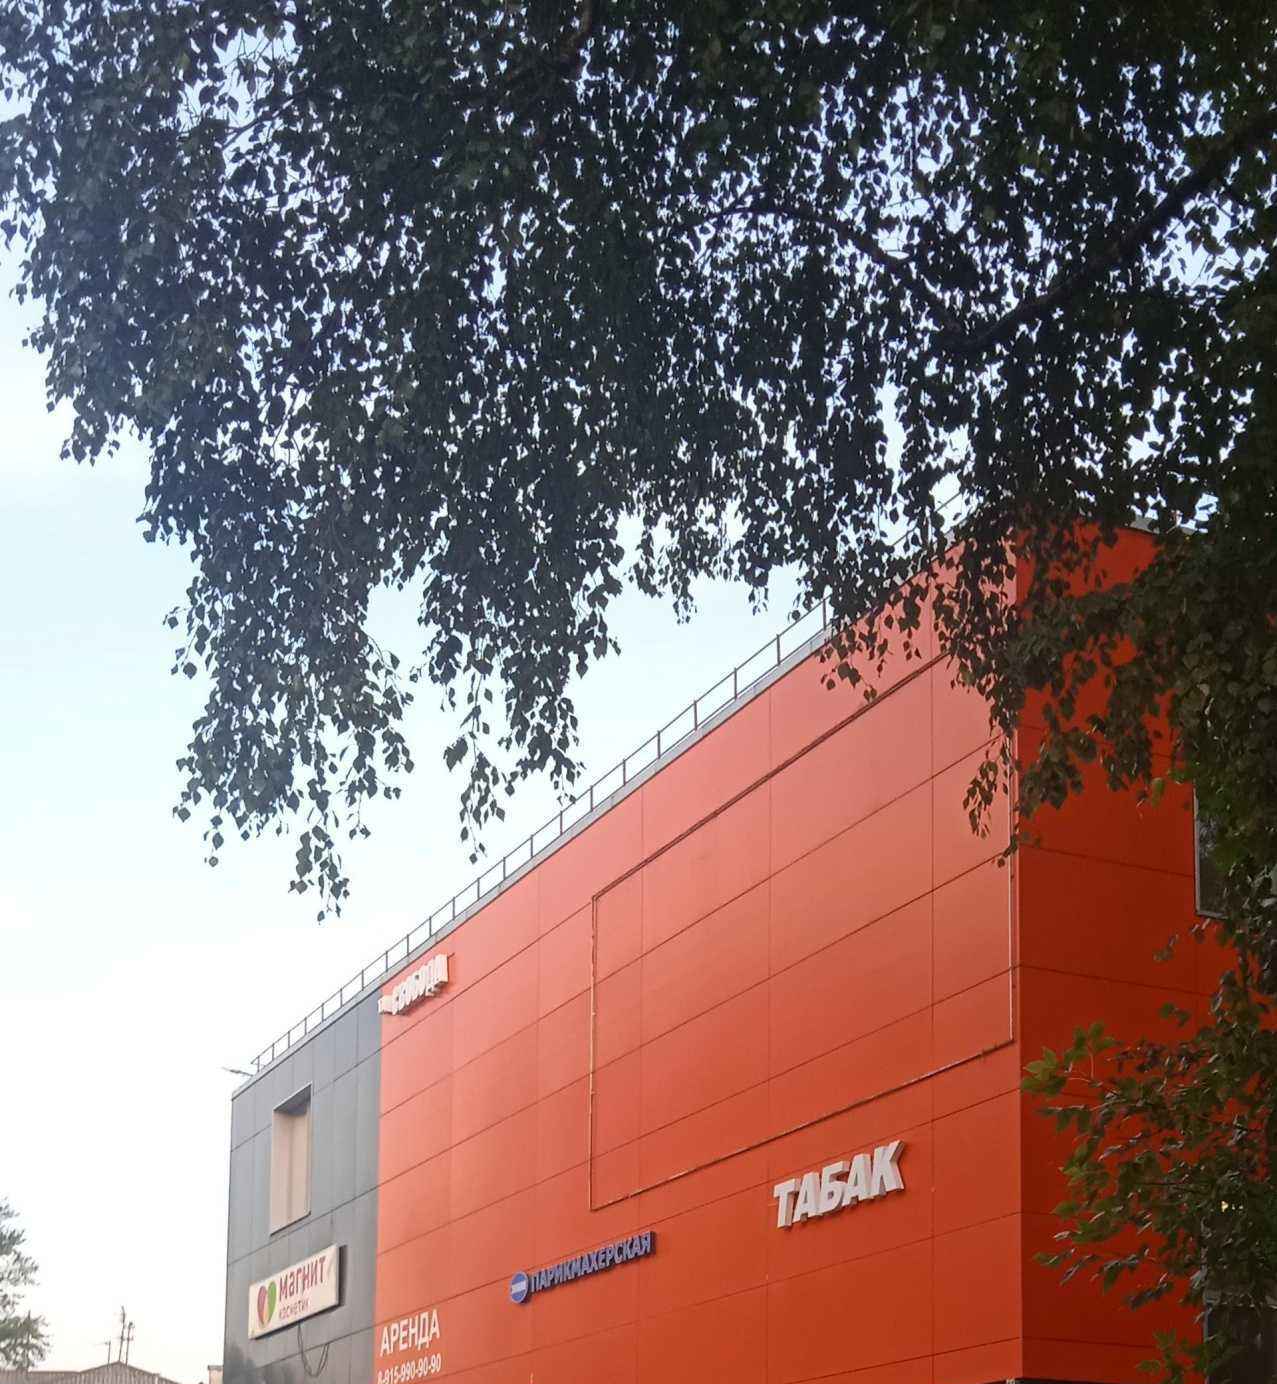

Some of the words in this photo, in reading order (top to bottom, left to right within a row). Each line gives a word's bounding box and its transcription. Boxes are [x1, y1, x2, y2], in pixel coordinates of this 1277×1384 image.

[773, 1139, 905, 1229] ТАБАК
[529, 1229, 655, 1293] ПАРИКМАХЕРСКАЯ
[380, 1308, 441, 1357] АРЕНДА
